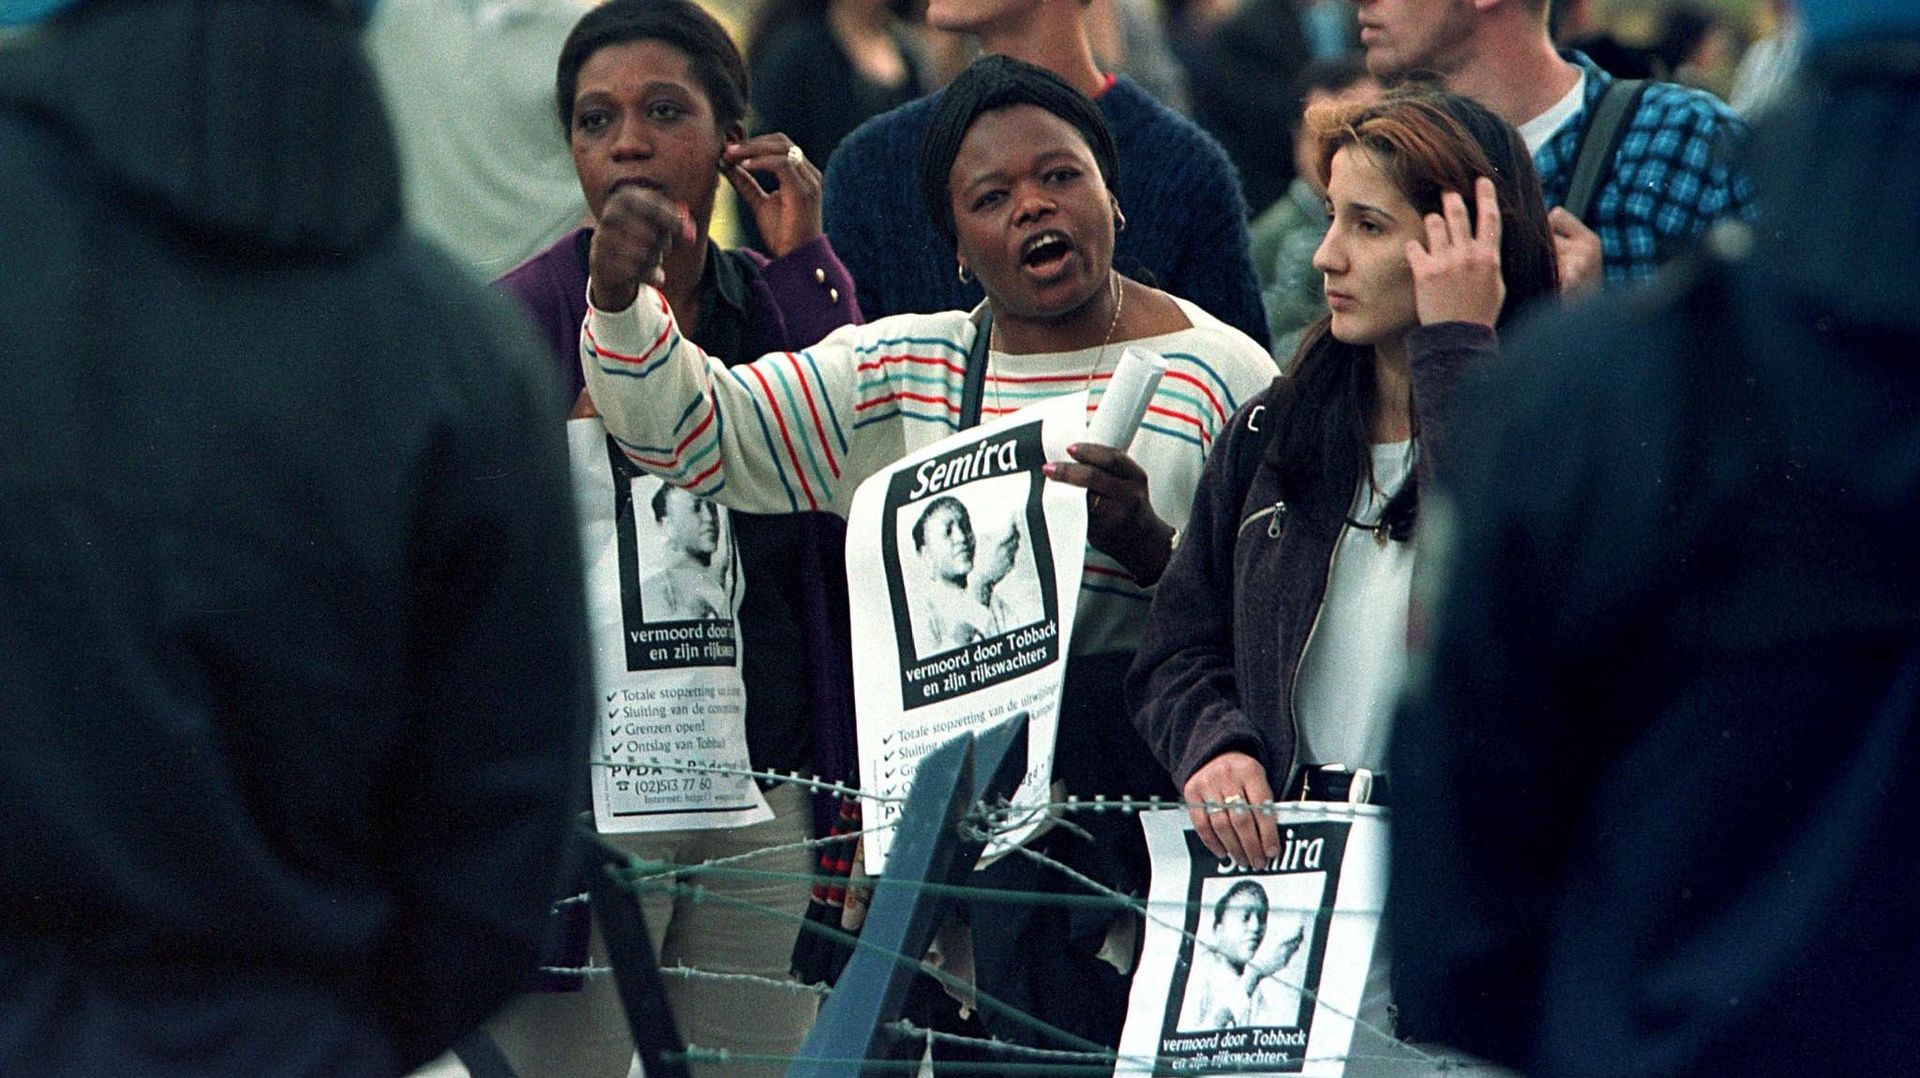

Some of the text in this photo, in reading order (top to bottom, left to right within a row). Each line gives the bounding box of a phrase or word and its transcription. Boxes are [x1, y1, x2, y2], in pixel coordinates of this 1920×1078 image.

[909, 440, 1018, 499] Semira
[630, 624, 704, 644] vermoord
[649, 648, 668, 662] en
[674, 643, 700, 662] zijn
[906, 620, 1057, 683] vermoord door Tobback
[923, 645, 1048, 697] en zijn rijkswachters
[622, 689, 656, 702] Totale
[660, 685, 715, 700] stopzetting
[623, 706, 667, 719] Sluiting
[671, 706, 689, 716] van
[692, 703, 705, 715] de
[898, 725, 930, 742] Totale
[932, 710, 985, 734] stopzetting
[988, 703, 1005, 717] van
[1007, 698, 1018, 711] de
[625, 720, 706, 736] Grenzen open!
[626, 739, 672, 753] Ontslag
[675, 741, 694, 750] van
[635, 778, 712, 795] (02)513 77 60
[1162, 1029, 1307, 1052] vermoord door Tobback
[1211, 1049, 1289, 1069] rijkswachters
